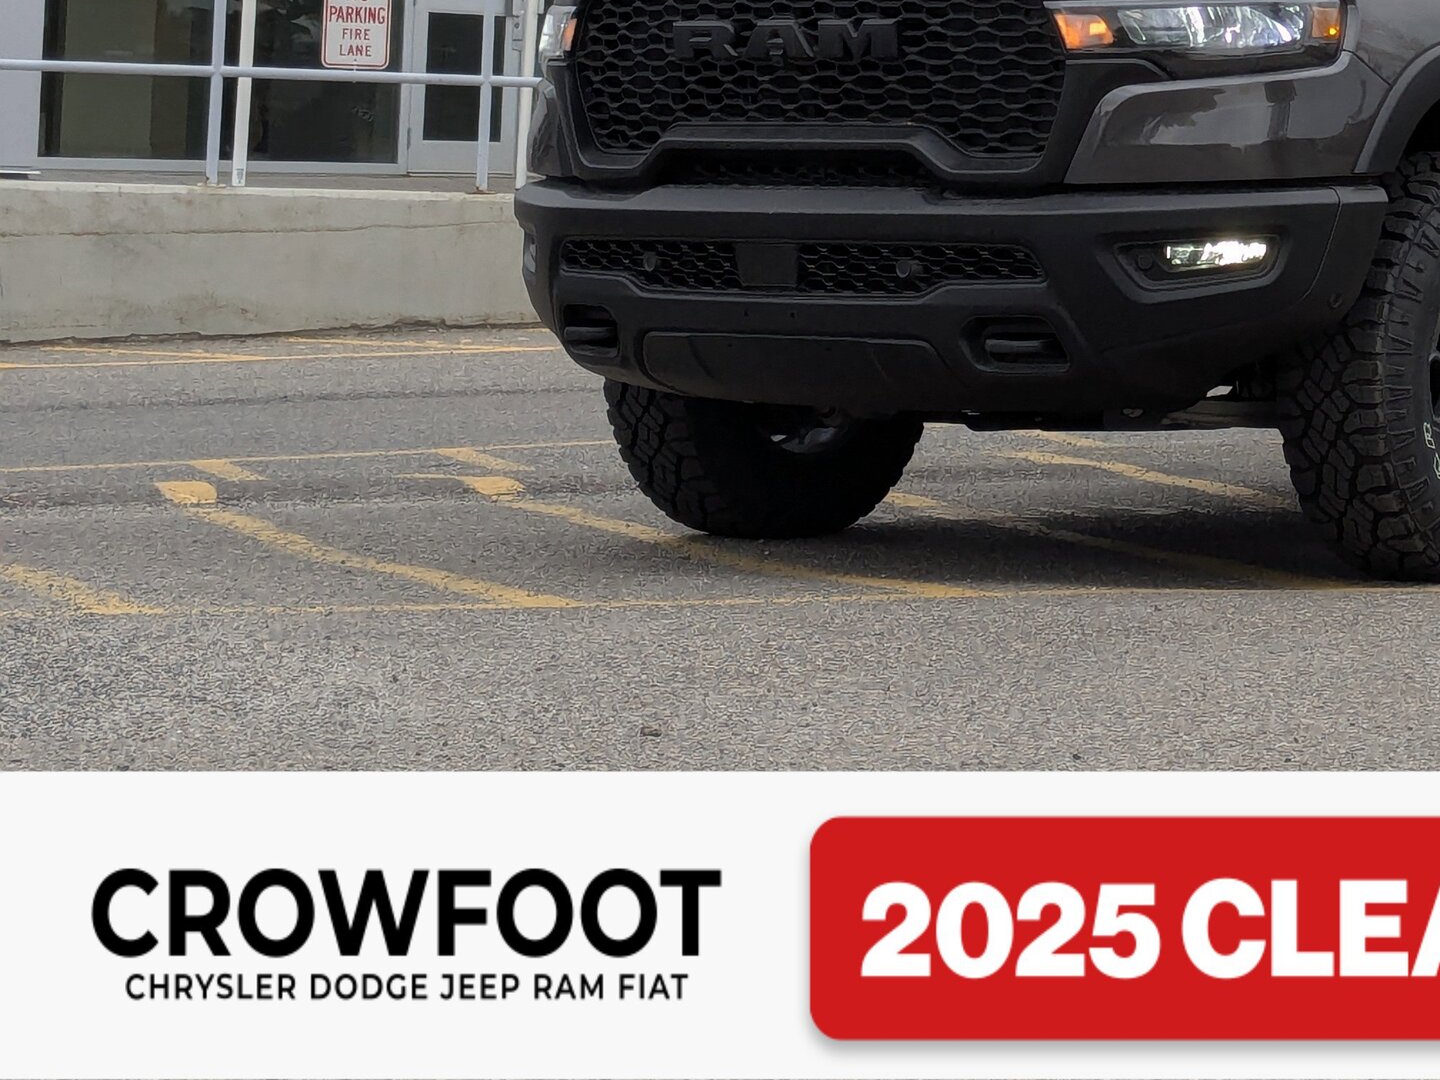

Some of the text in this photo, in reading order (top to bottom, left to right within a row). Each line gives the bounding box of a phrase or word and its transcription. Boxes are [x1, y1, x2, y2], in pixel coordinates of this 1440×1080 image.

[329, 6, 386, 25] PARKING
[342, 28, 371, 41] FIRE
[672, 20, 898, 60] RAM
[339, 45, 372, 57] LANE
